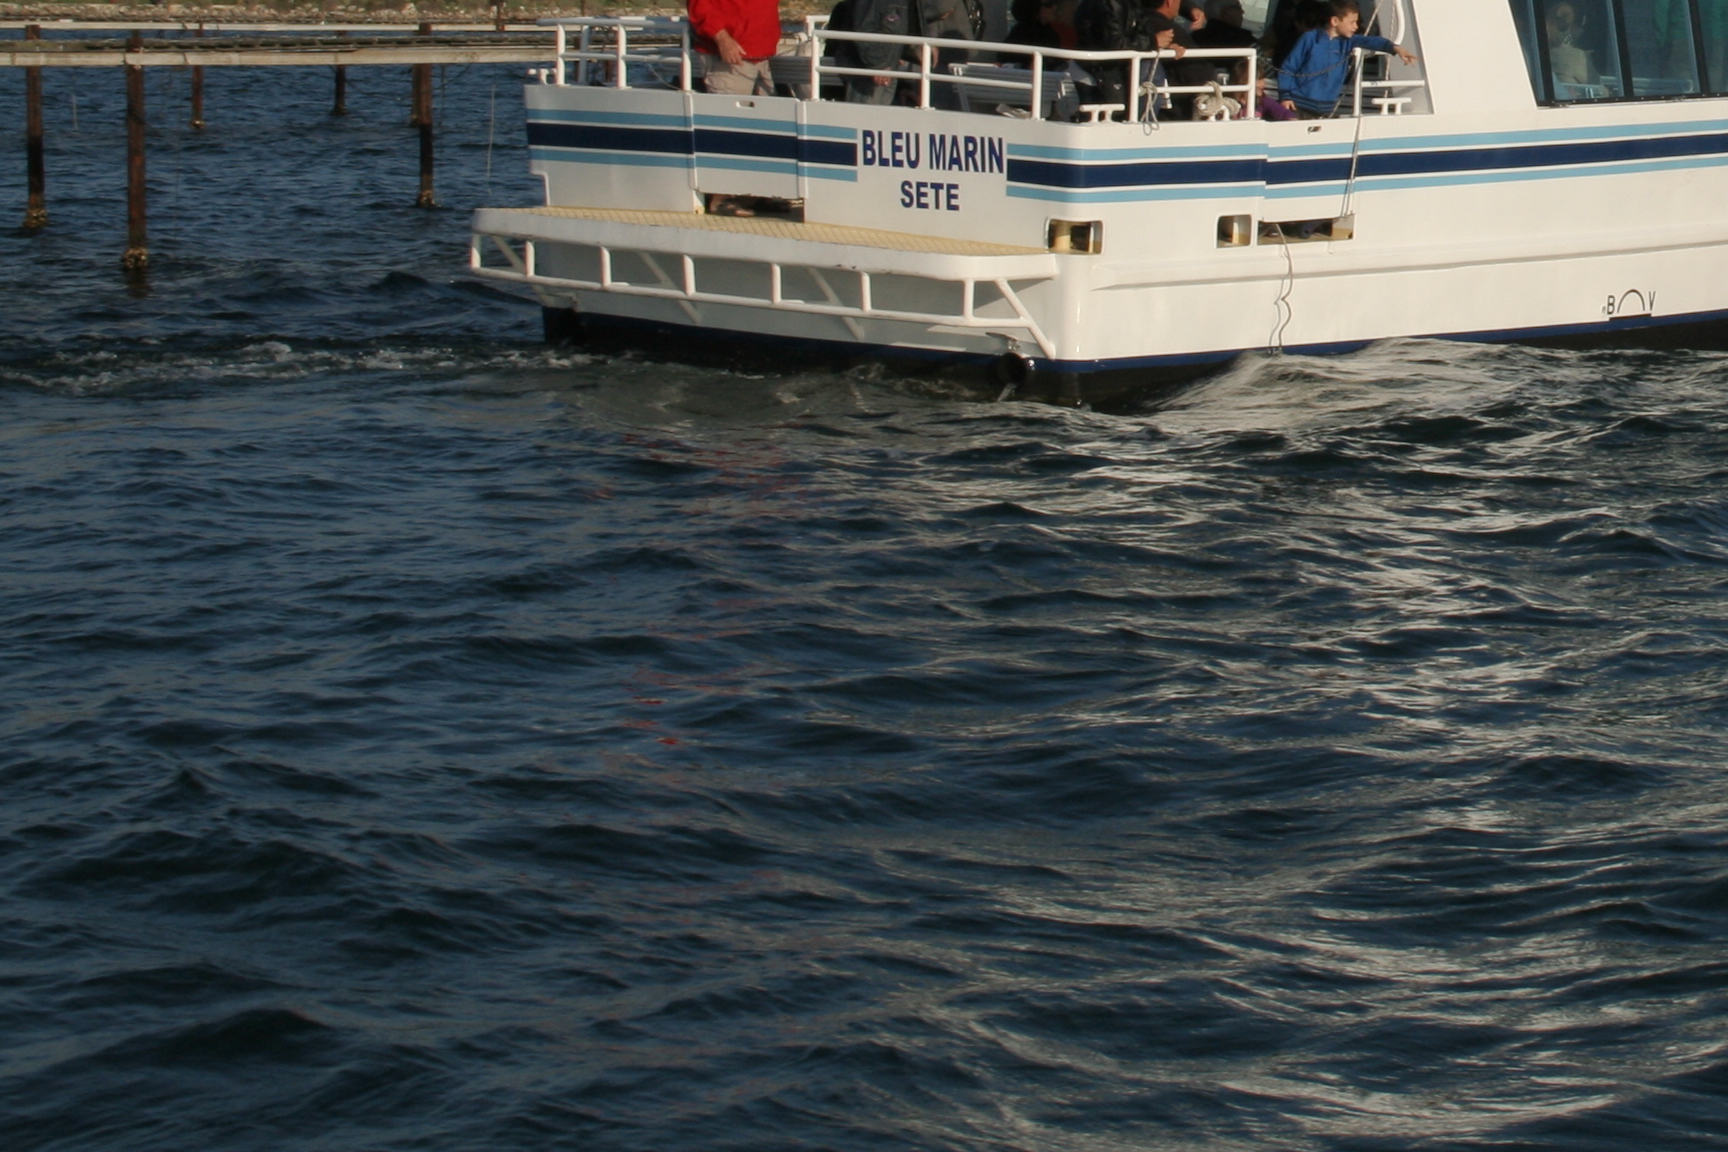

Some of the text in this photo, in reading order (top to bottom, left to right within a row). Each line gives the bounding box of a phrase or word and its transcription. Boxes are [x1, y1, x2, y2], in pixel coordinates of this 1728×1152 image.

[862, 129, 1004, 174] BLEU MARIN
[900, 180, 960, 211] SETE
[1607, 295, 1615, 315] B
